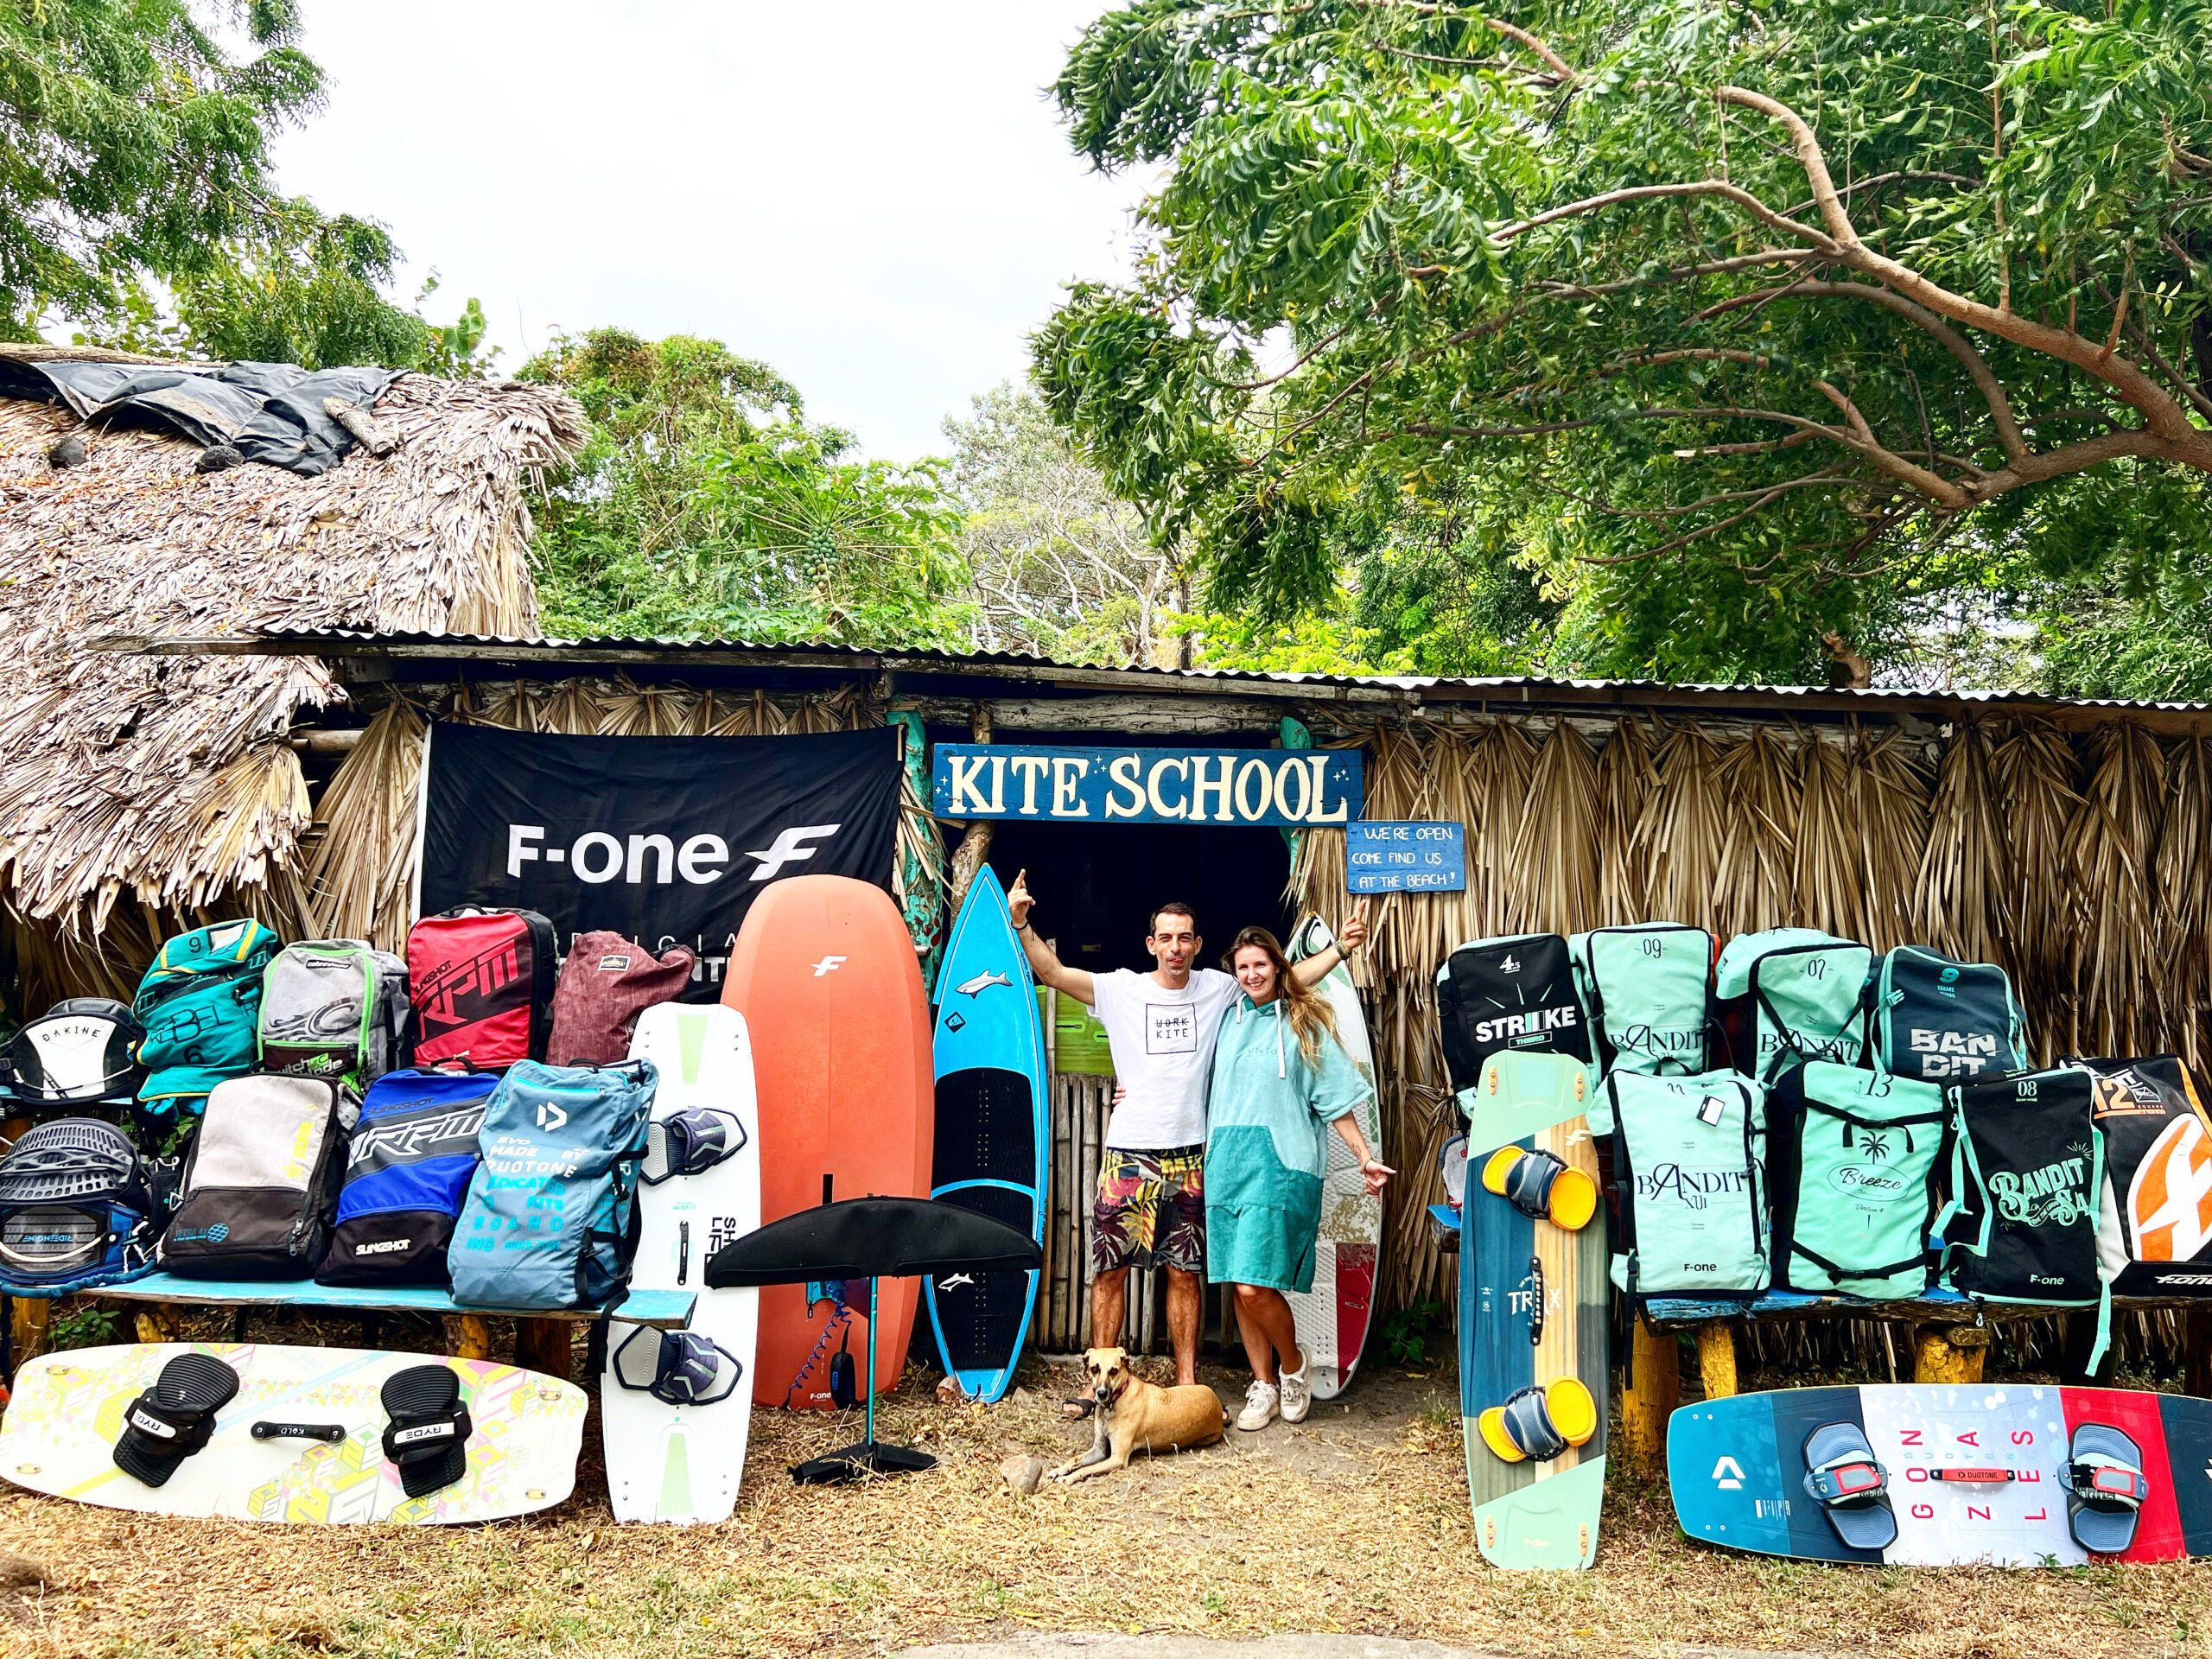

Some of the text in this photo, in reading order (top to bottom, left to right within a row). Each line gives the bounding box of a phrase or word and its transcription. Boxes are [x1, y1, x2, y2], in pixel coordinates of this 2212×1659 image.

[949, 752, 1348, 823] KITE SCHOOL
[1364, 826, 1452, 841] WE'RE OPEN
[507, 824, 729, 884] F-one
[1352, 852, 1442, 865] COME FIND US
[1359, 876, 1376, 888] AT
[1380, 876, 1401, 887] THE
[188, 936, 202, 953] 9
[1643, 938, 1662, 958] 09
[1808, 959, 1826, 980] 07
[1939, 968, 1960, 982] 9
[1155, 1018, 1190, 1028] WORK
[41, 1026, 101, 1042] DAKINE
[1156, 1028, 1189, 1039] KITE
[1909, 1028, 2003, 1057] BAN
[1922, 1053, 1986, 1077] DIT
[1865, 1071, 1894, 1097] 13
[2018, 1080, 2037, 1096] 08
[496, 1136, 531, 1145] EVO
[489, 1145, 590, 1160] MADE BY
[1637, 1163, 1745, 1201] BANDIT
[1839, 1167, 1903, 1190] Breeze
[1989, 1157, 2085, 1221] BANDIT
[526, 1195, 564, 1211] KITE
[355, 1238, 411, 1256] SLINGSHOT
[465, 1236, 494, 1252] ING
[1684, 1262, 1717, 1272] F-one
[2030, 1274, 2065, 1286] F-one
[1507, 1287, 1561, 1317] TRX
